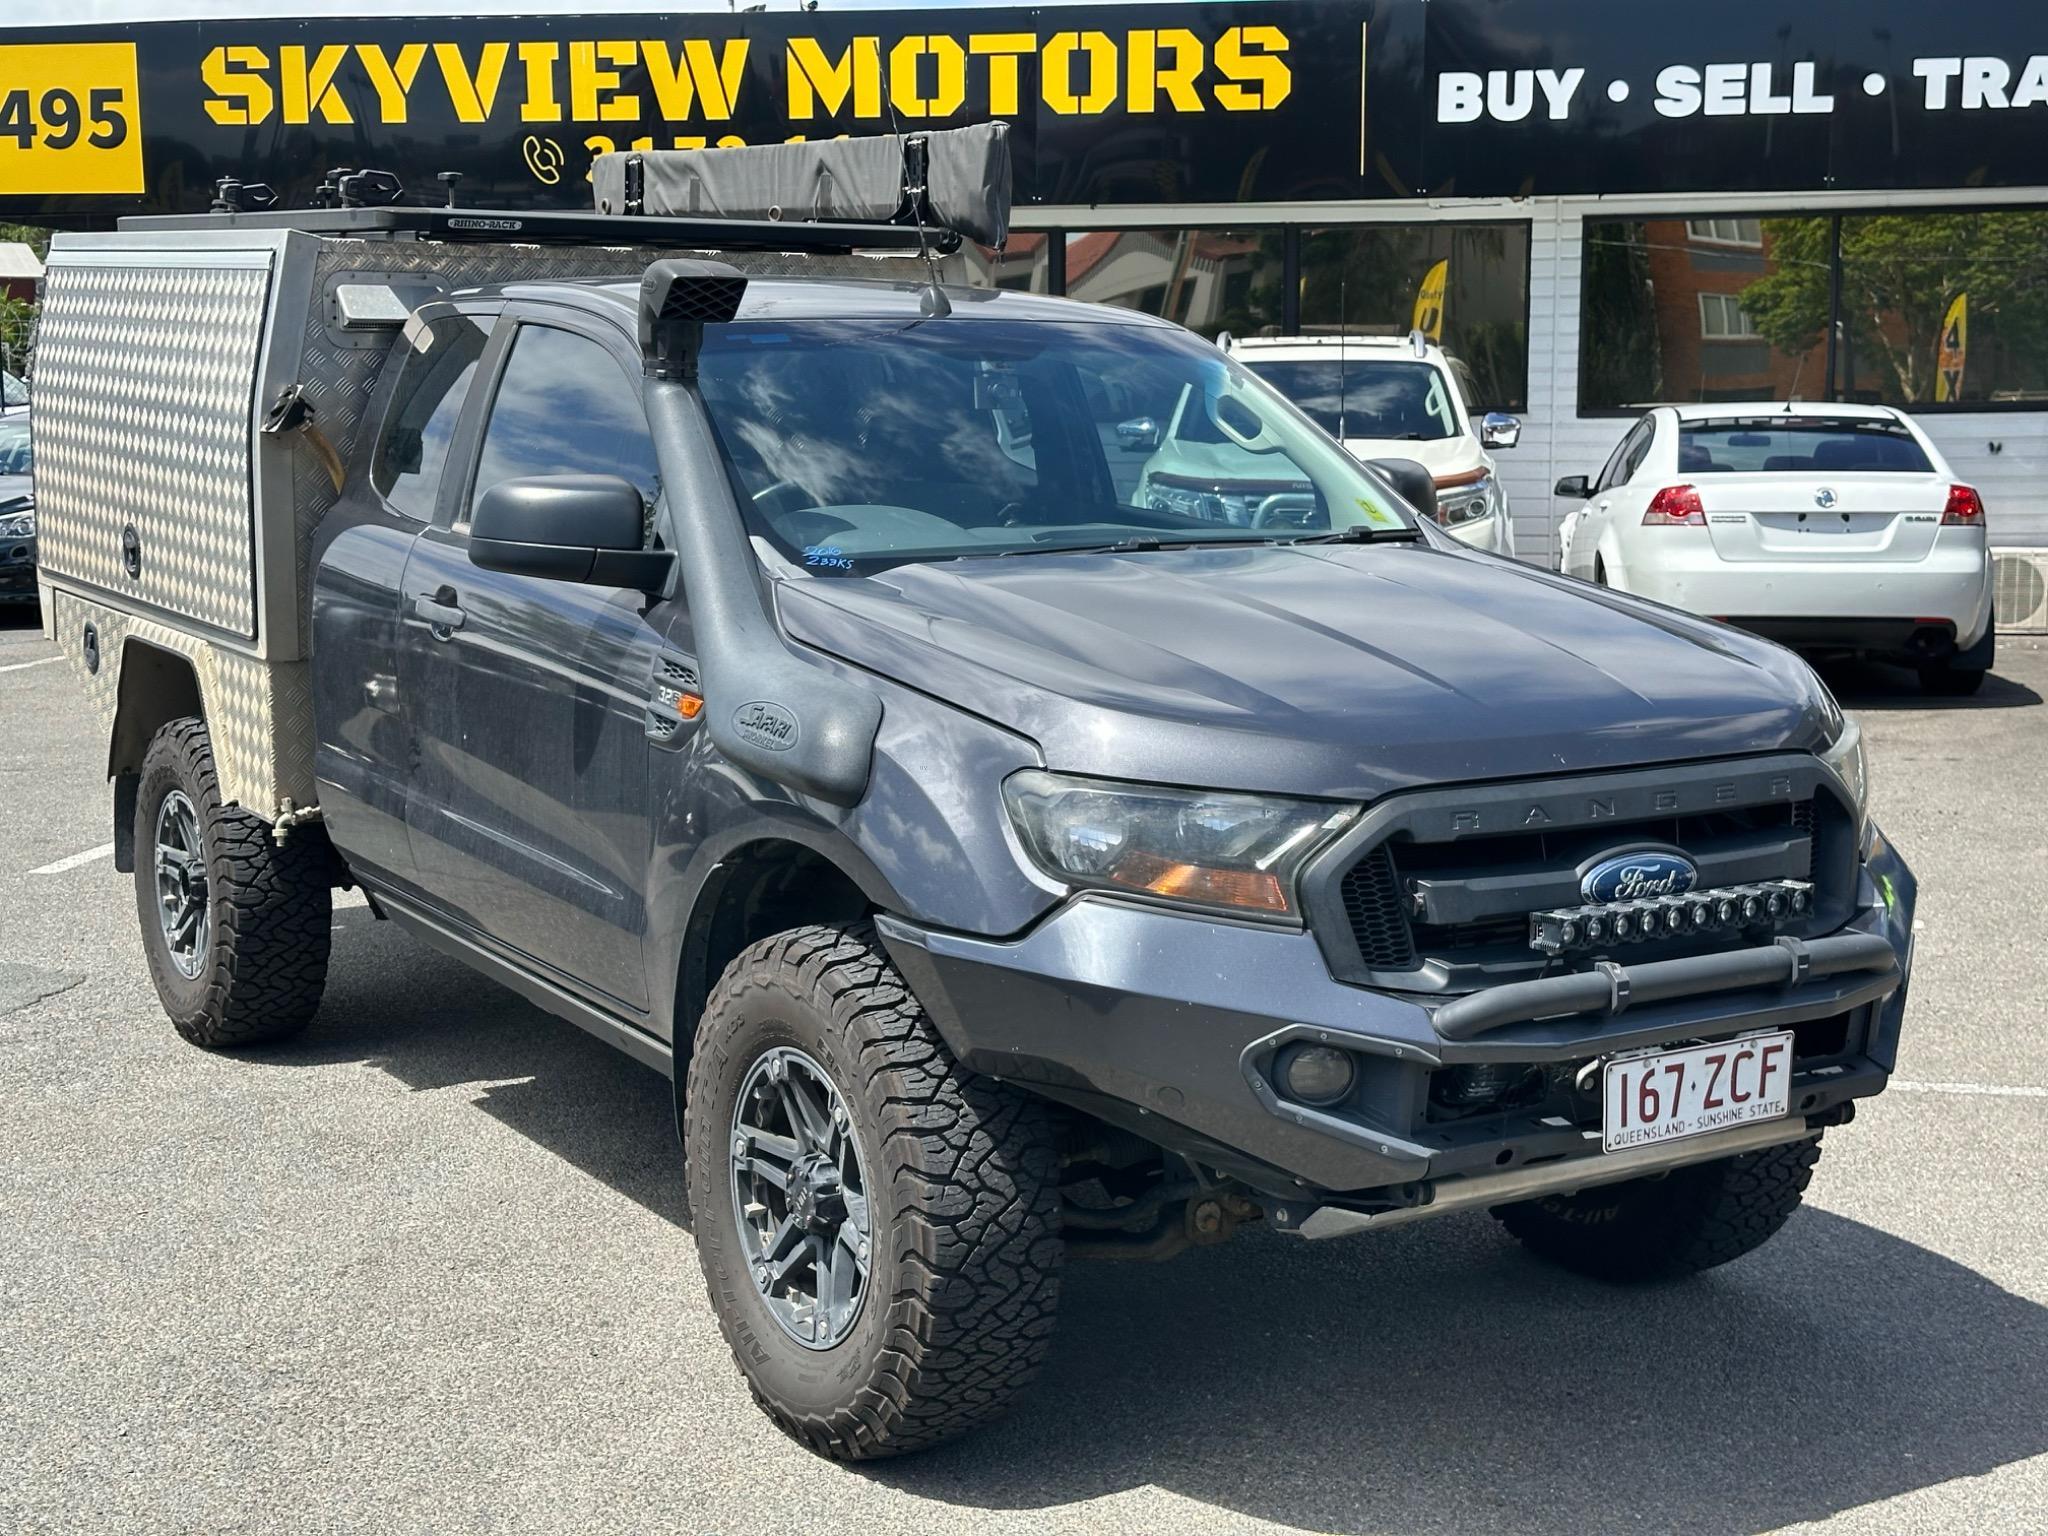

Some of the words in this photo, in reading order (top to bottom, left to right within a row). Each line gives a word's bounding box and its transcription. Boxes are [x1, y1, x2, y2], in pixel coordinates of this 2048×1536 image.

[200, 38, 750, 125] SKYVIEW
[786, 25, 1292, 120] MOTORS
[1437, 67, 1586, 123] BUY
[1653, 62, 1835, 118] SELL
[1912, 55, 2048, 110] TRA
[0, 87, 128, 150] 495
[453, 218, 517, 230] RHINO-RACK
[1450, 775, 1792, 831] RANGER
[1614, 864, 1677, 898] Ford
[1619, 1062, 1685, 1128] 167
[1703, 1043, 1784, 1110] ZCF
[1613, 1119, 1686, 1146] QUEENSLAND
[1696, 1106, 1744, 1130] SUNSHINE
[1749, 1099, 1782, 1116] STATE
